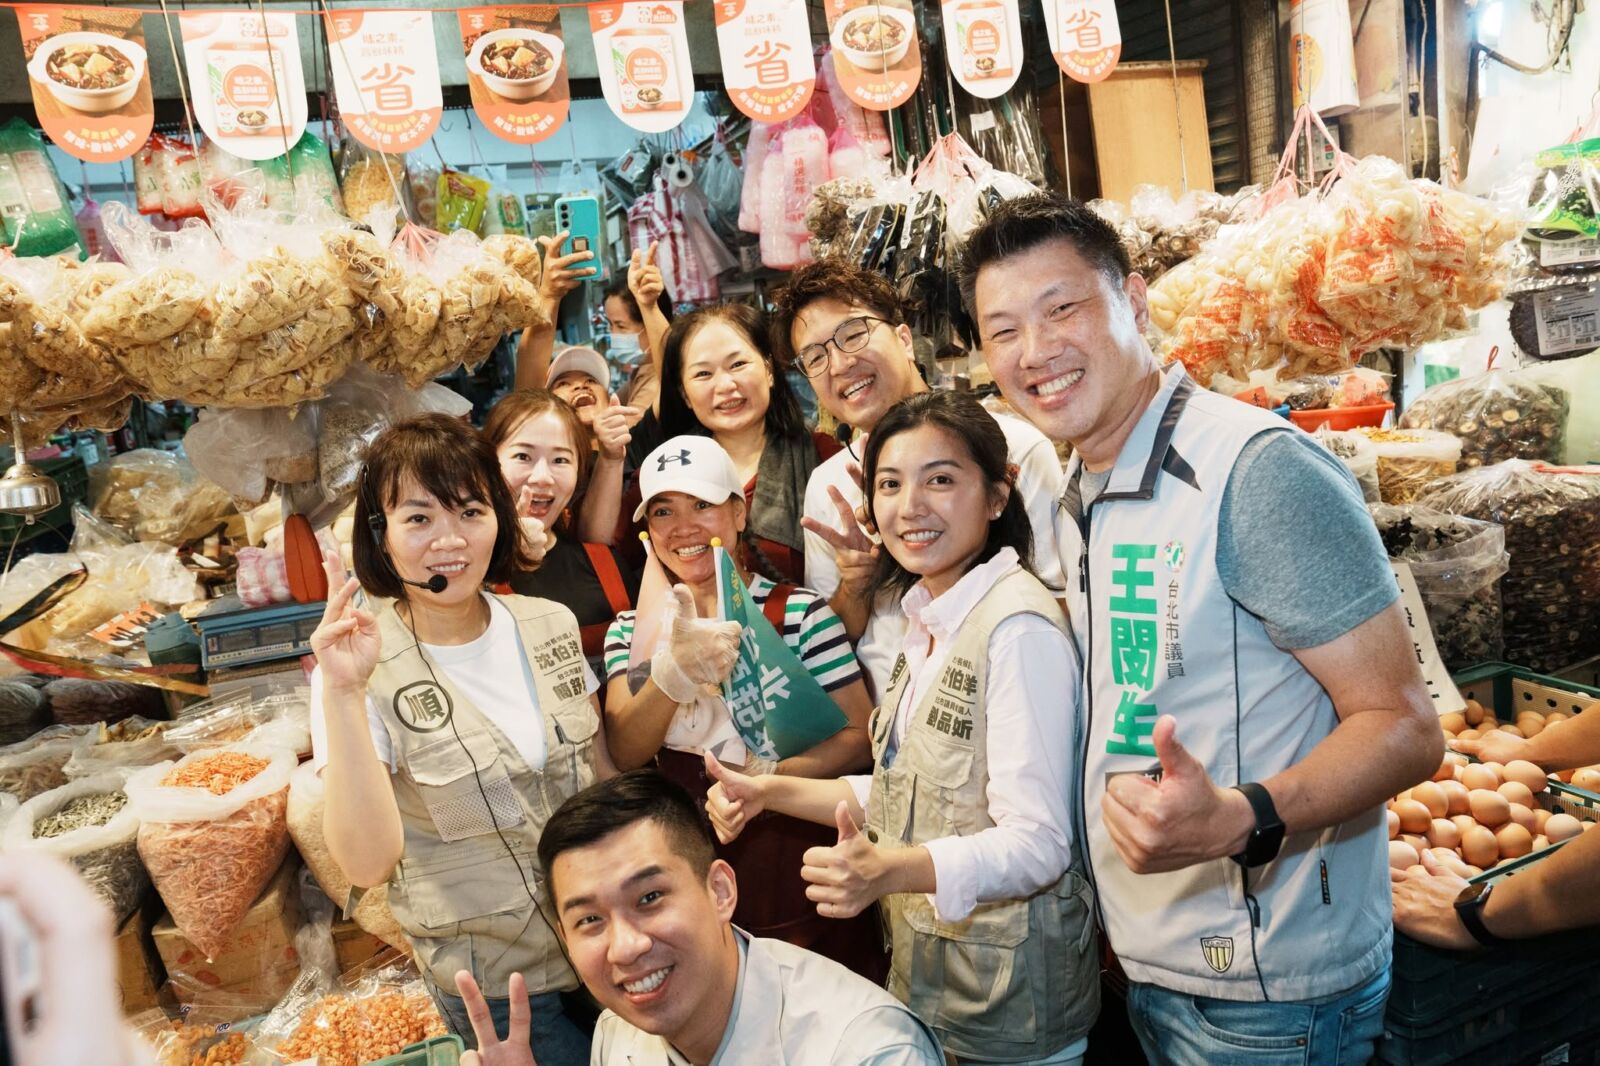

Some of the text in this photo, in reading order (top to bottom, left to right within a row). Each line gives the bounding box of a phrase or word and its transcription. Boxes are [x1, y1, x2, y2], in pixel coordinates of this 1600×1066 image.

[1066, 9, 1101, 48] 省
[744, 40, 791, 84] 省
[361, 63, 416, 111] 省
[1164, 580, 1186, 680] 台北市議員
[404, 687, 446, 725] 順
